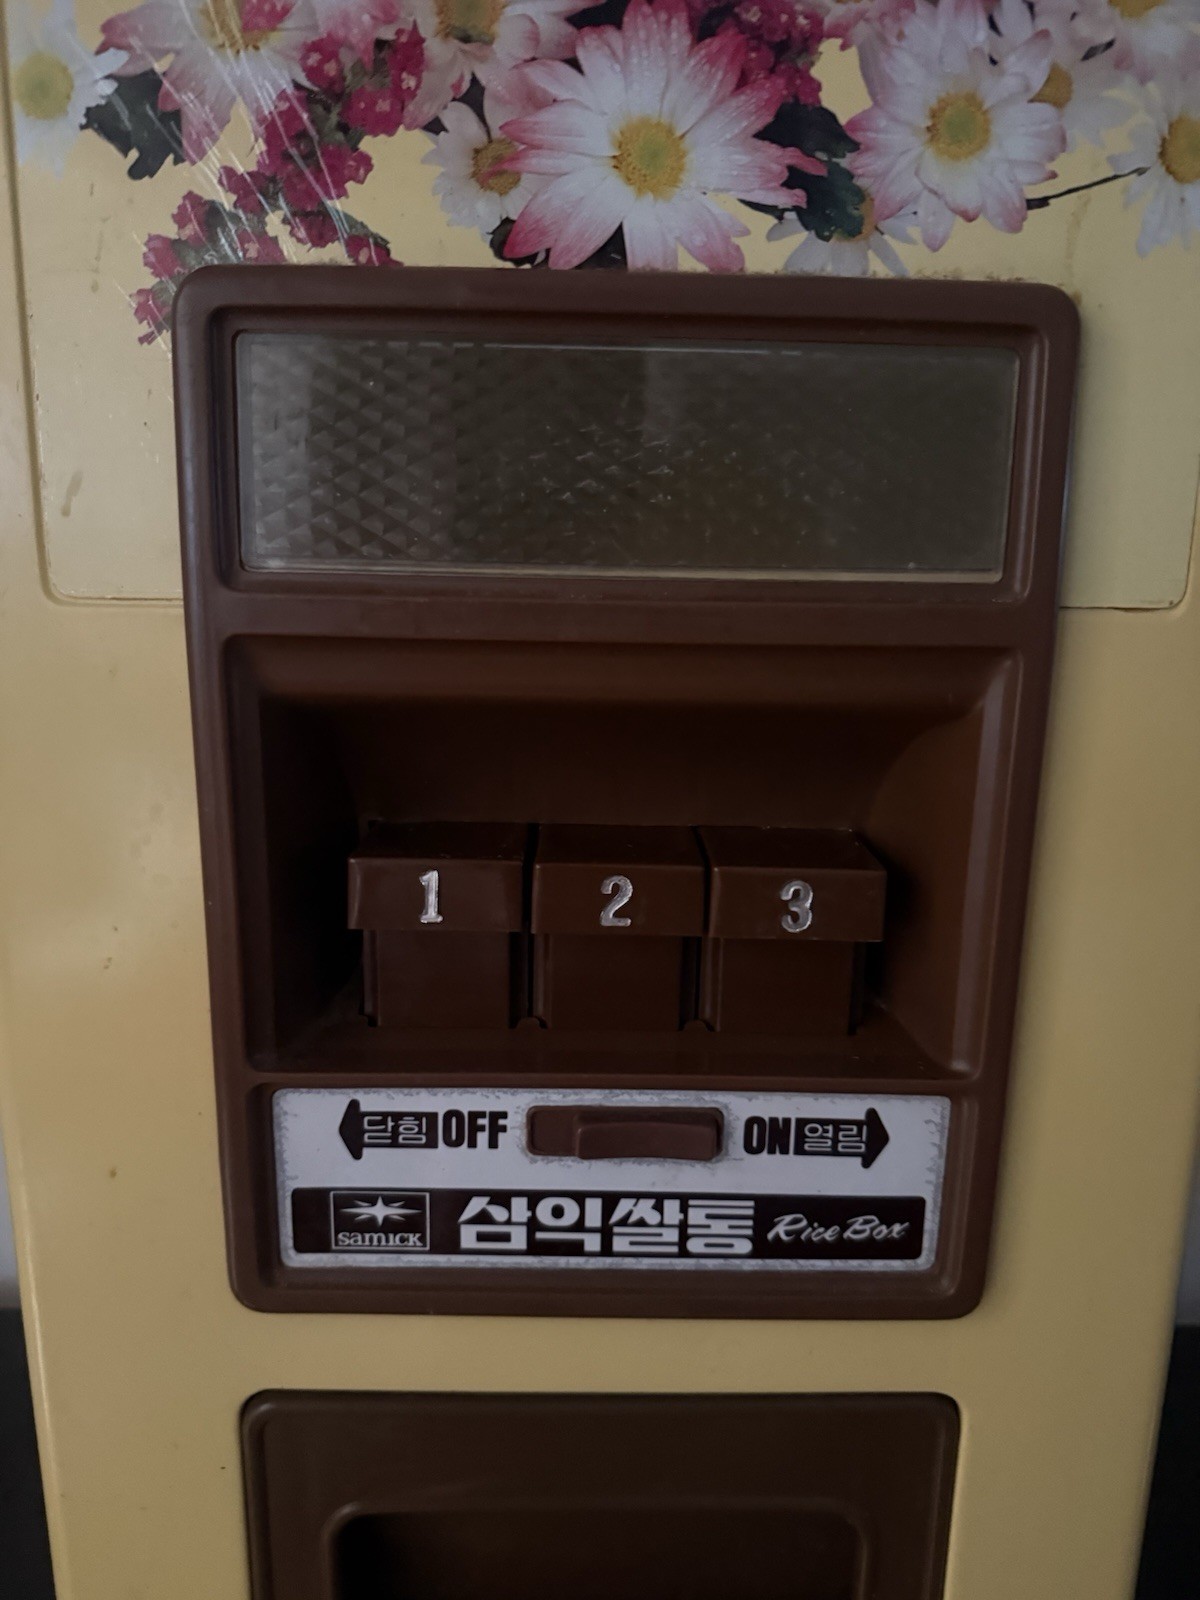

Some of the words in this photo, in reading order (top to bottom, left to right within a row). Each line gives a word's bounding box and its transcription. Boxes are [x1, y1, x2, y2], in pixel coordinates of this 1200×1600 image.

[419, 869, 444, 924] 1
[600, 874, 634, 927] 2
[779, 879, 815, 933] 3
[363, 1114, 427, 1144] 닫힘
[442, 1109, 508, 1149] OFF
[743, 1115, 791, 1155] ON
[803, 1121, 868, 1152] 열림
[457, 1195, 755, 1255] 삼익쌀통
[766, 1213, 839, 1243] Rice
[842, 1214, 910, 1241] Box
